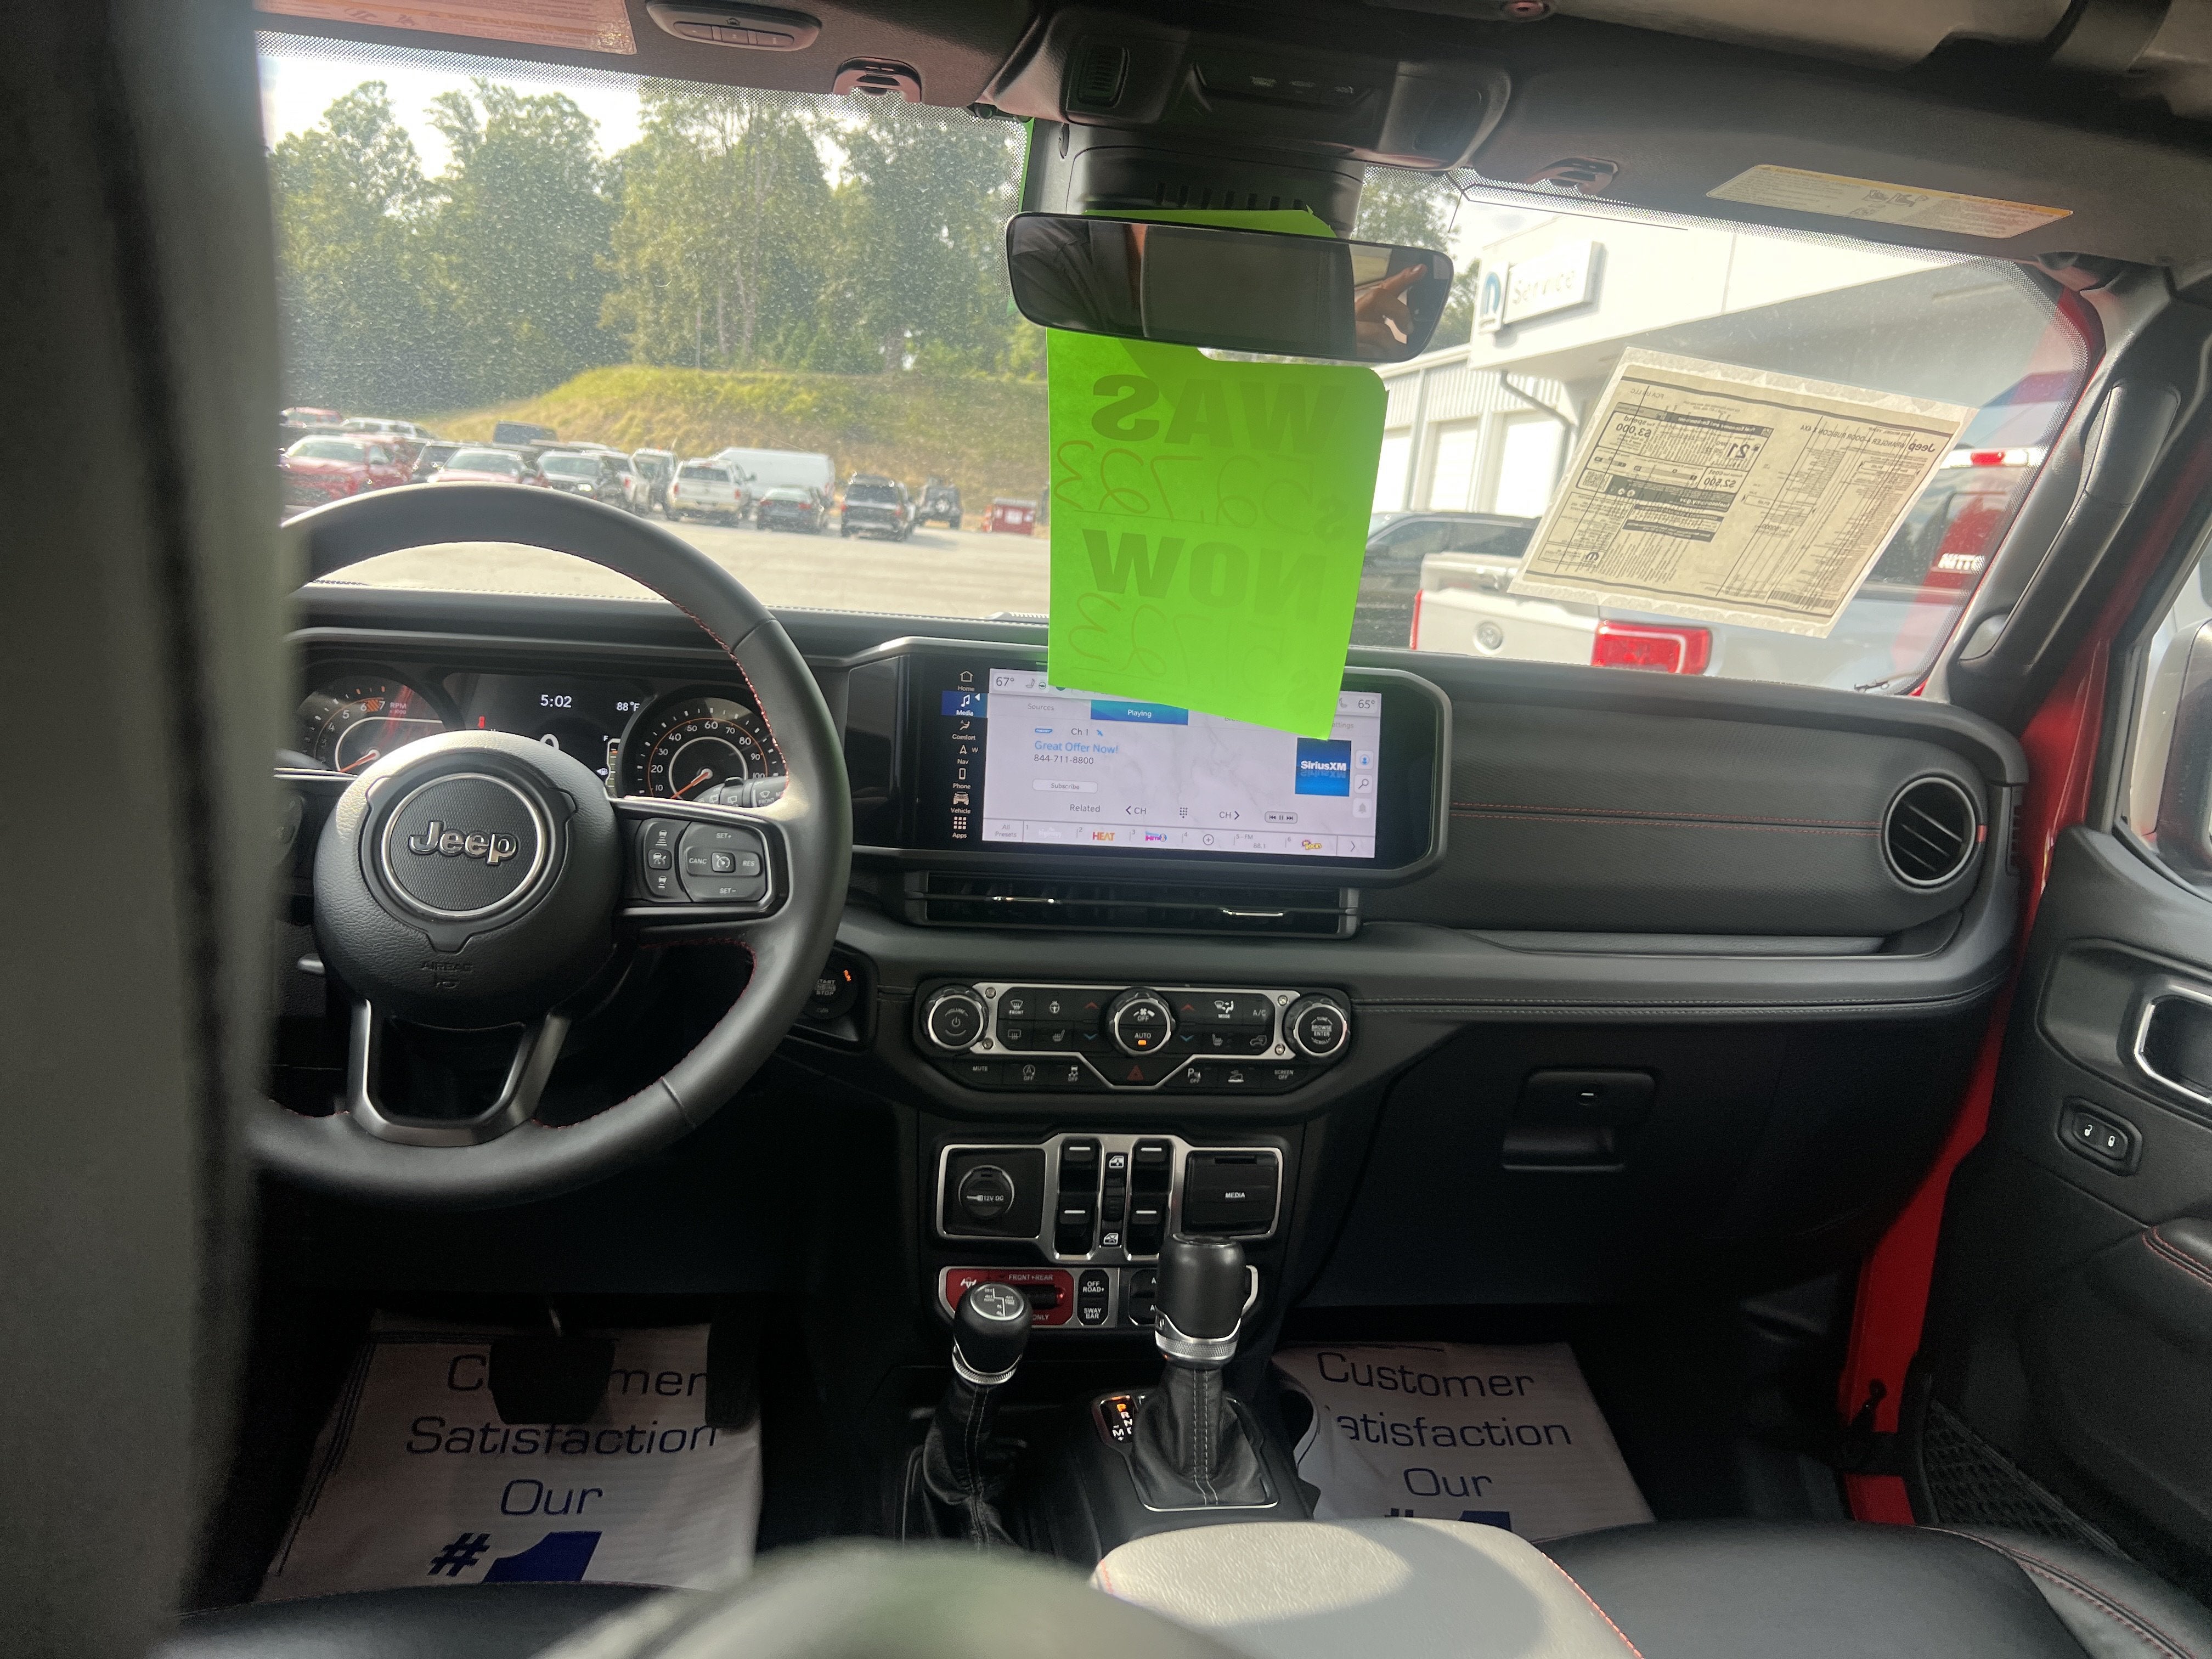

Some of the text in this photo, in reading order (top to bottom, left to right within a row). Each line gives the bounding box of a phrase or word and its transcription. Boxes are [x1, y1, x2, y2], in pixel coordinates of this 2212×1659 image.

[996, 677, 1014, 686] 67°
[379, 701, 386, 710] 7
[540, 695, 572, 708] 5:02
[1358, 699, 1375, 709] 65°
[360, 703, 367, 712] 6
[342, 709, 350, 719] 5
[1127, 709, 1152, 718] Playing
[704, 721, 718, 730] 60
[669, 733, 681, 741] 40
[740, 737, 752, 745] 80
[1035, 741, 1119, 753] Great Offer Now!
[1034, 754, 1094, 764] 844-711-8800
[651, 765, 663, 773] 20
[1301, 761, 1346, 771] SiriusXM
[1070, 804, 1101, 812] Related
[1092, 832, 1115, 841] HEAT
[409, 821, 520, 866] Jeep
[447, 1353, 707, 1397] Cmer
[1317, 1351, 1534, 1397] Customer
[1112, 1429, 1124, 1437] M
[1335, 1411, 1572, 1448] atisfaction
[406, 1415, 716, 1455] Satisfaction
[1403, 1468, 1493, 1498] Our
[500, 1479, 603, 1516] Our
